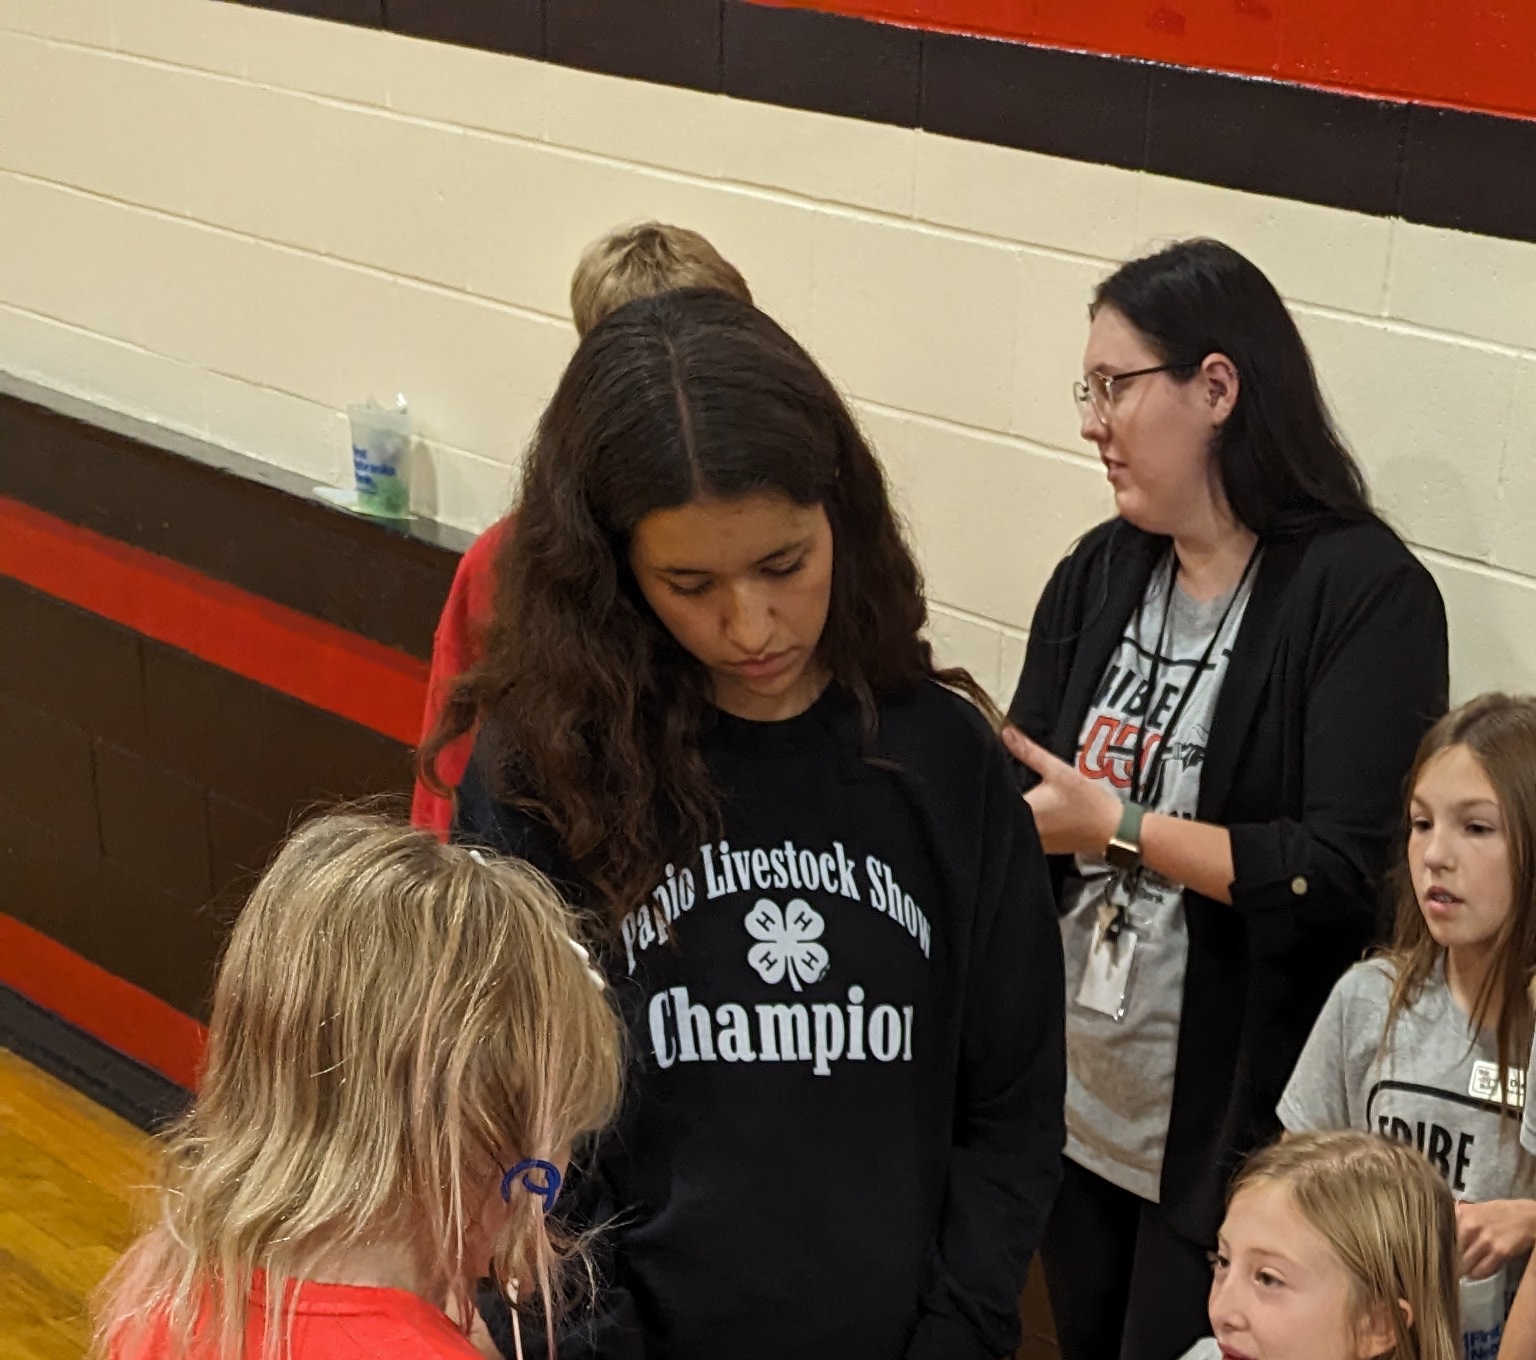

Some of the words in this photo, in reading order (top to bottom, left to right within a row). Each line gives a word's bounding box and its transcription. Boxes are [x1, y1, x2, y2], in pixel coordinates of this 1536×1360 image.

[619, 863, 696, 976] Papio
[700, 840, 861, 901] Livestock
[865, 855, 931, 959] Show
